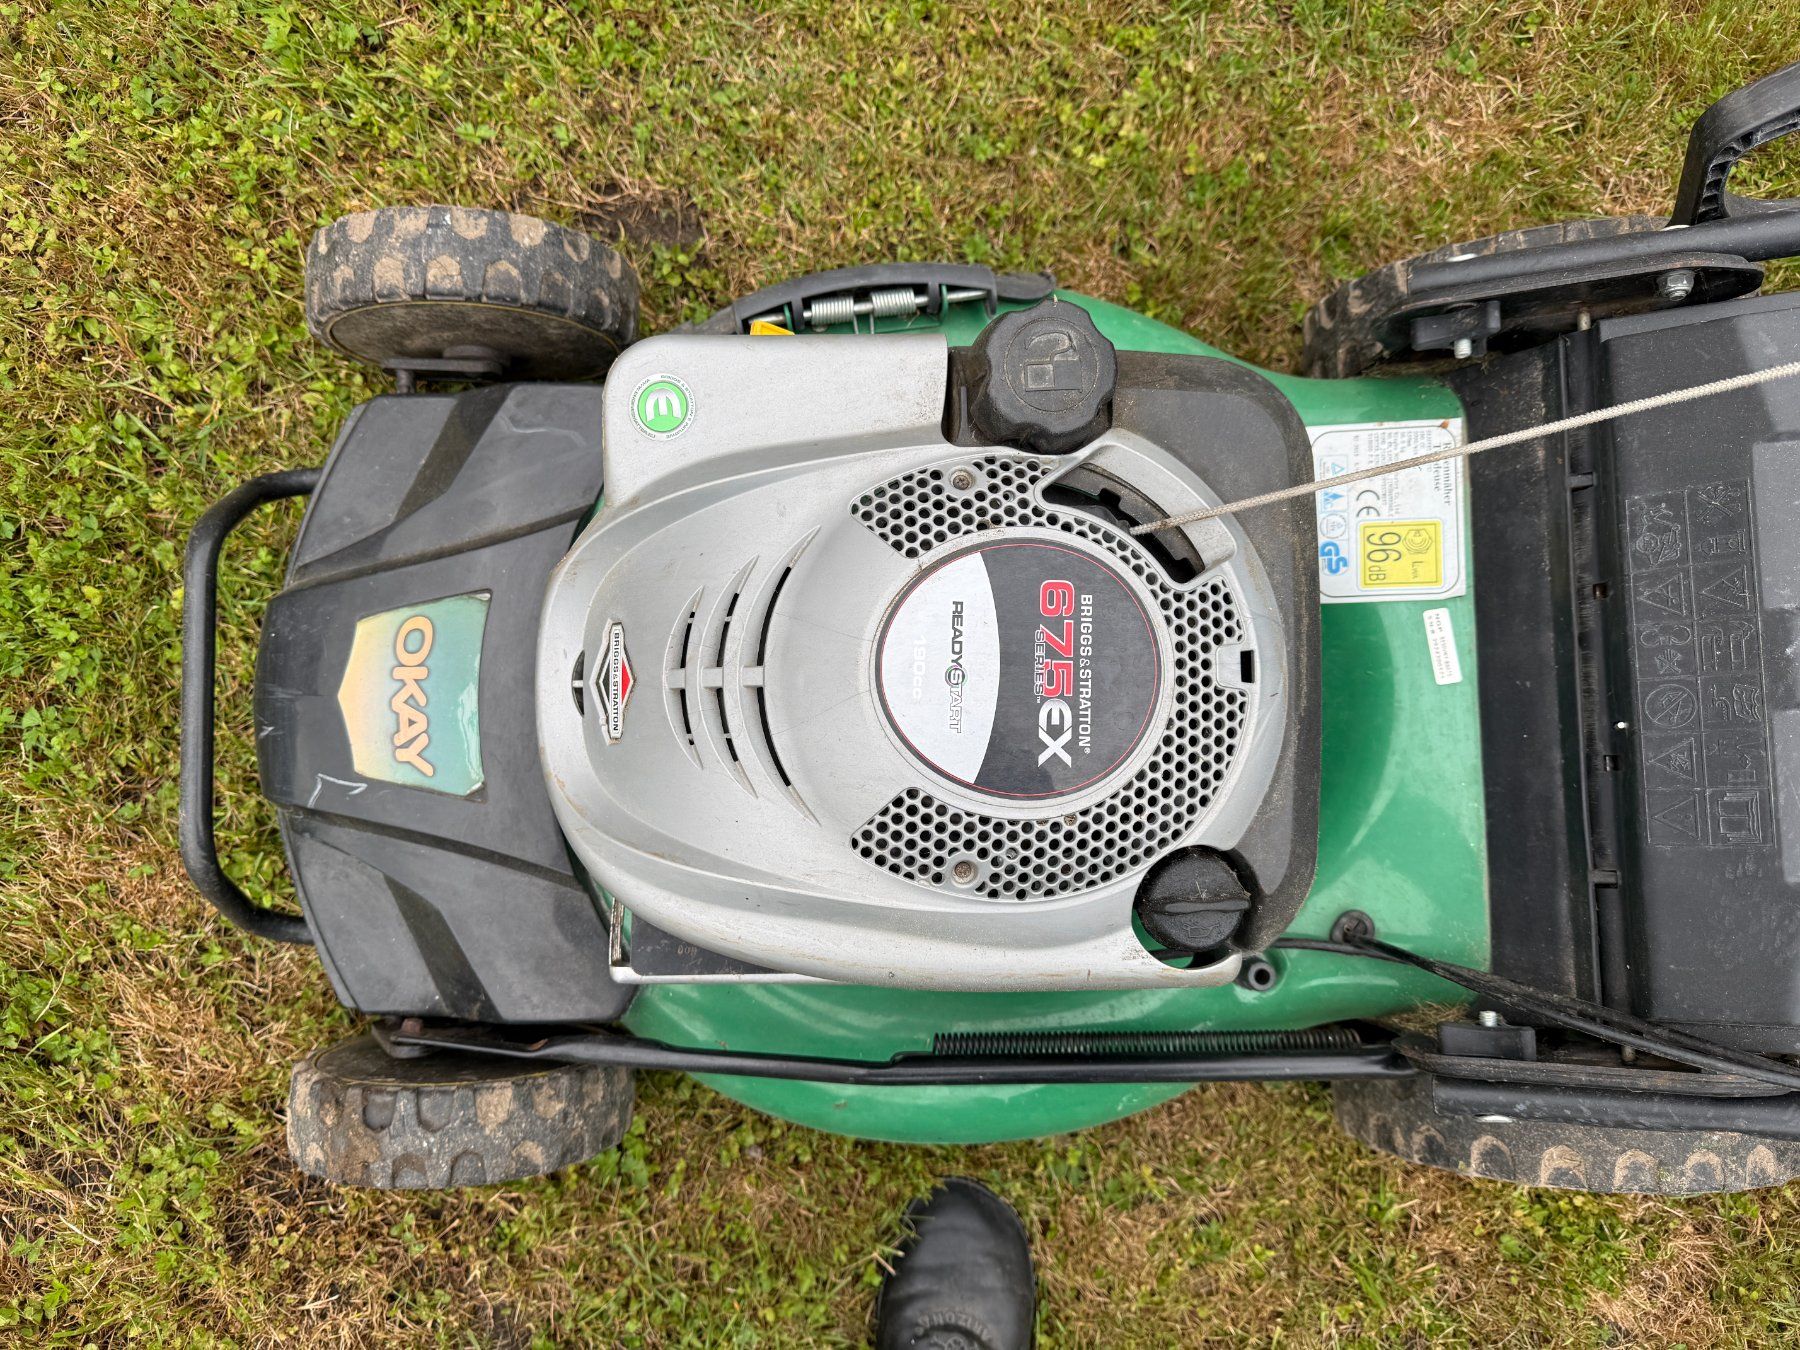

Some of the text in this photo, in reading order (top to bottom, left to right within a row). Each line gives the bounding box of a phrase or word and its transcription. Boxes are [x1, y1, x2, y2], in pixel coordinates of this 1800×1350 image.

[1356, 490, 1380, 518] CE
[1320, 542, 1348, 575] GS
[1366, 532, 1402, 582] 96 dB
[390, 615, 434, 777] OKAY
